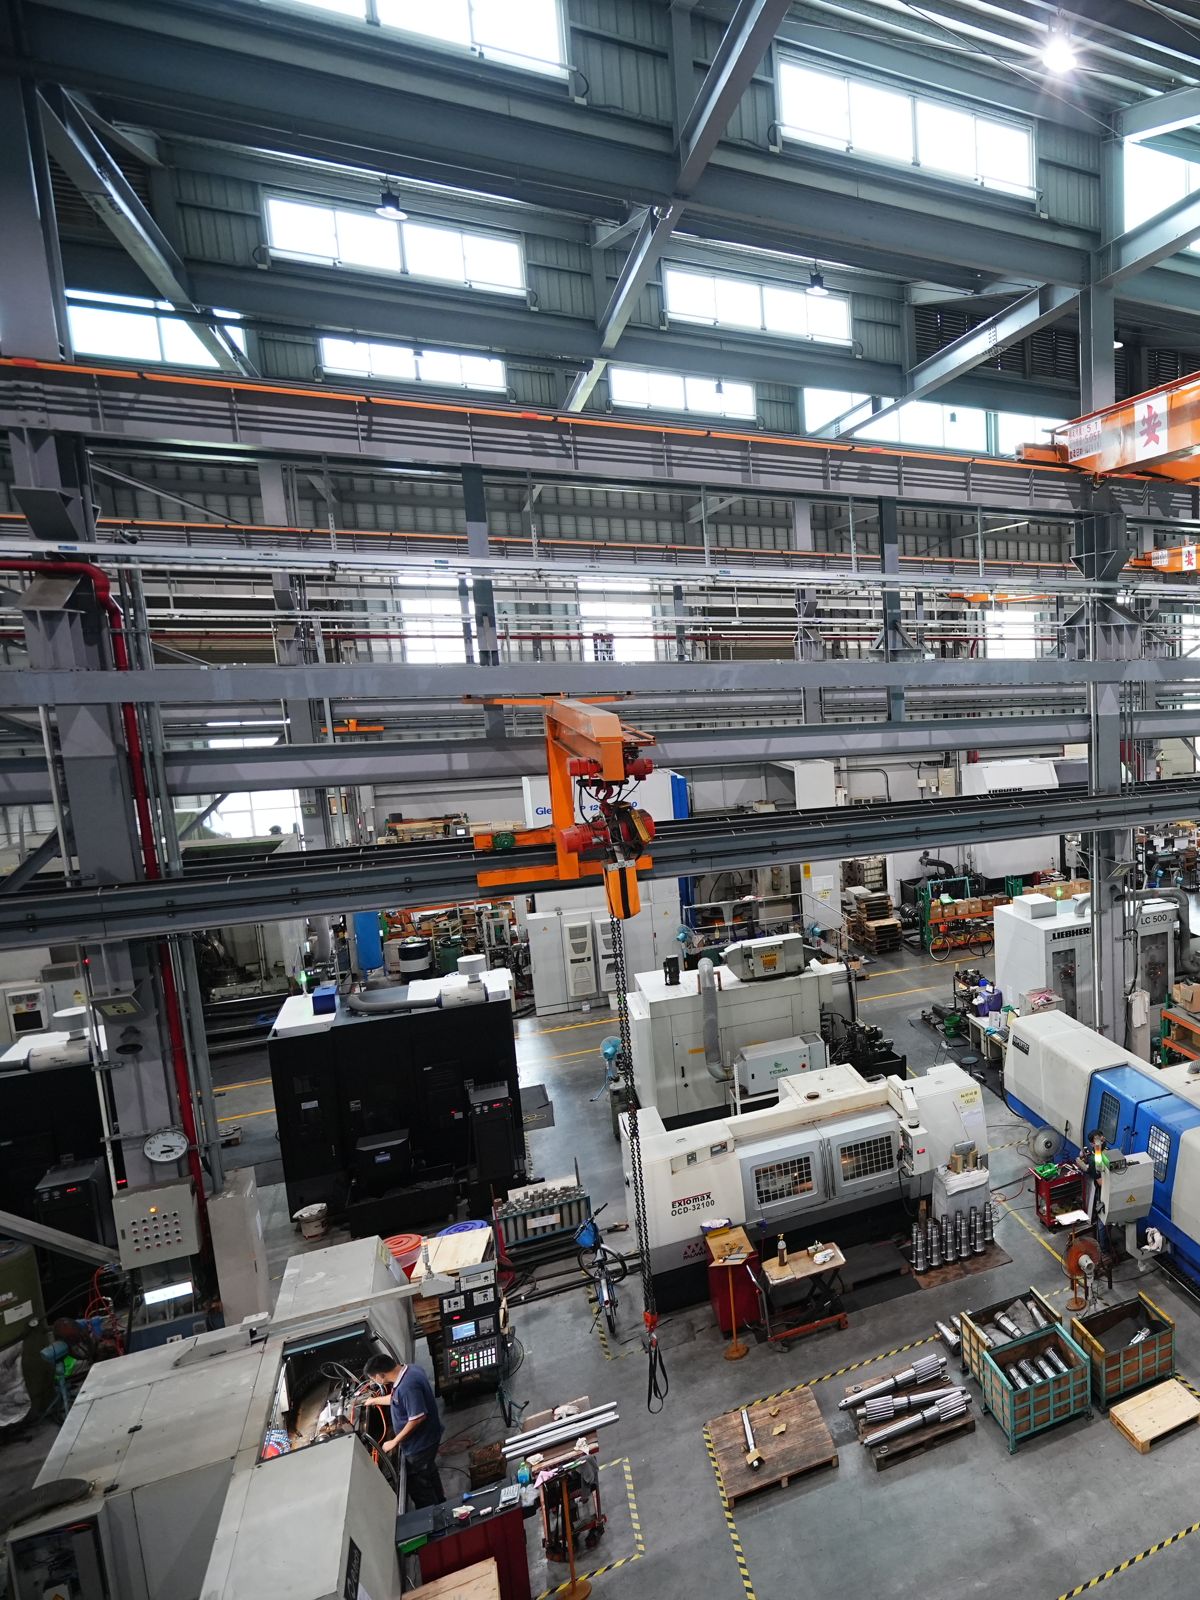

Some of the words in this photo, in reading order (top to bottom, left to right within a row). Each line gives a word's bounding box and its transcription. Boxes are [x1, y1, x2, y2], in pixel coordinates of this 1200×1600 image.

[1139, 404, 1162, 448] 安
[1184, 551, 1194, 567] 安
[1140, 916, 1151, 924] LC
[1152, 913, 1168, 923] 500
[1052, 927, 1091, 939] LIEBHER
[671, 1200, 715, 1216] OCD-32100
